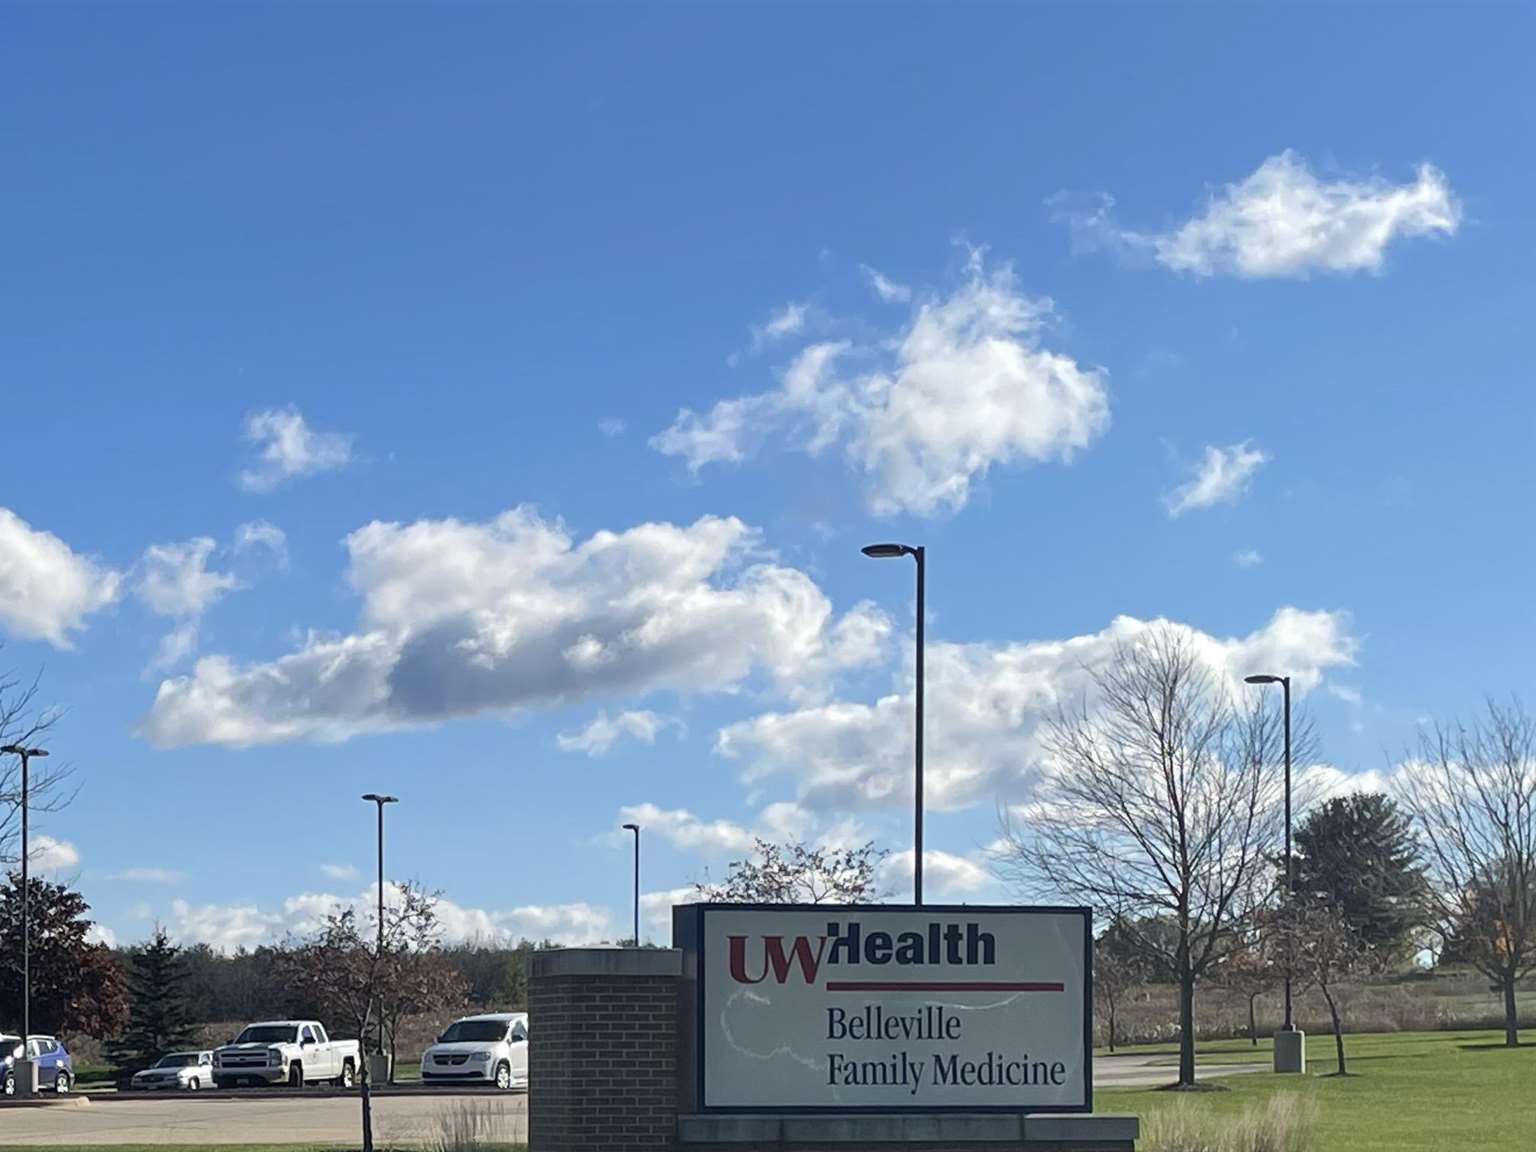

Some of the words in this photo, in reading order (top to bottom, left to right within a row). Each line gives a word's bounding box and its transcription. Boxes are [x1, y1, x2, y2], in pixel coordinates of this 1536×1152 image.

[727, 937, 826, 984] UW
[827, 923, 995, 965] Health
[827, 1006, 961, 1040] Belleville
[827, 1052, 925, 1094] Family
[933, 1053, 1066, 1086] Medicine
